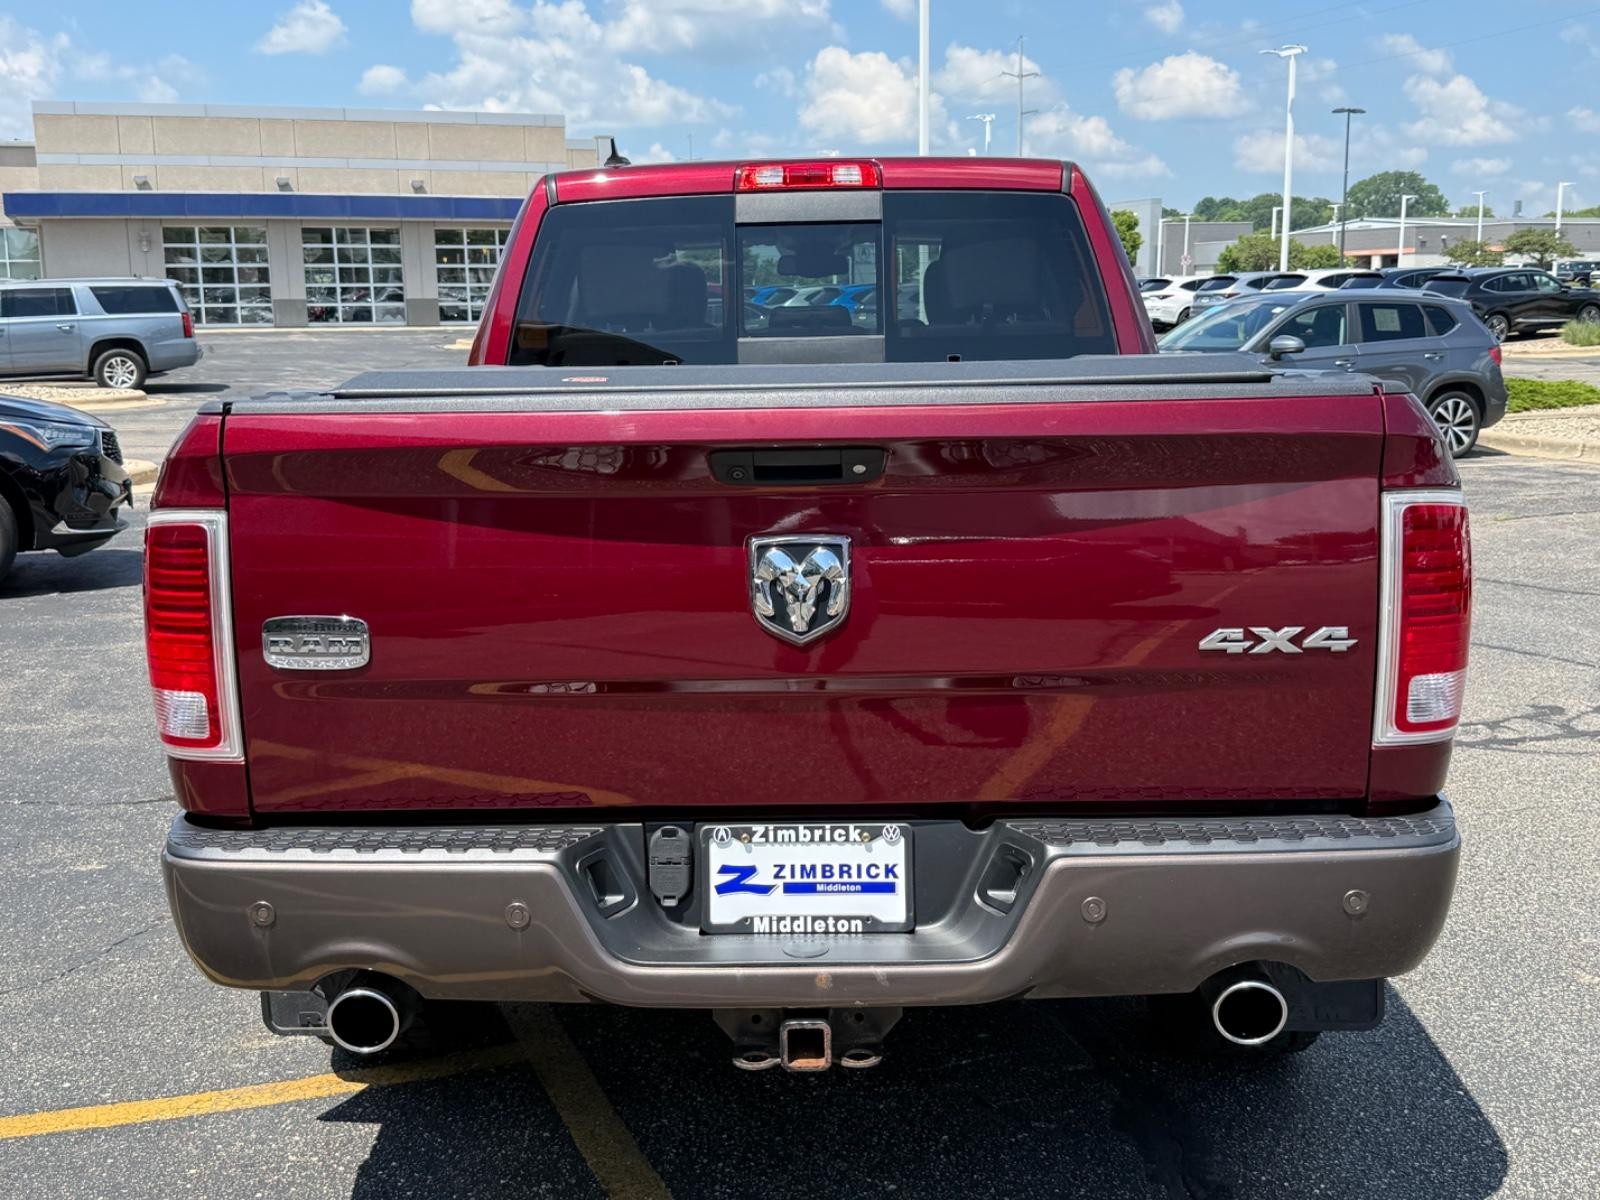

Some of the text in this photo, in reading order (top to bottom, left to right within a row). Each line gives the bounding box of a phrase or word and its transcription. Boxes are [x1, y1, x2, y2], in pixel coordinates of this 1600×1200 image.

[269, 637, 362, 653] RAM
[752, 825, 863, 843] Zimbrick
[773, 864, 900, 879] ZIMBRICK
[816, 884, 861, 892] Middleton
[753, 916, 863, 933] Middleton
